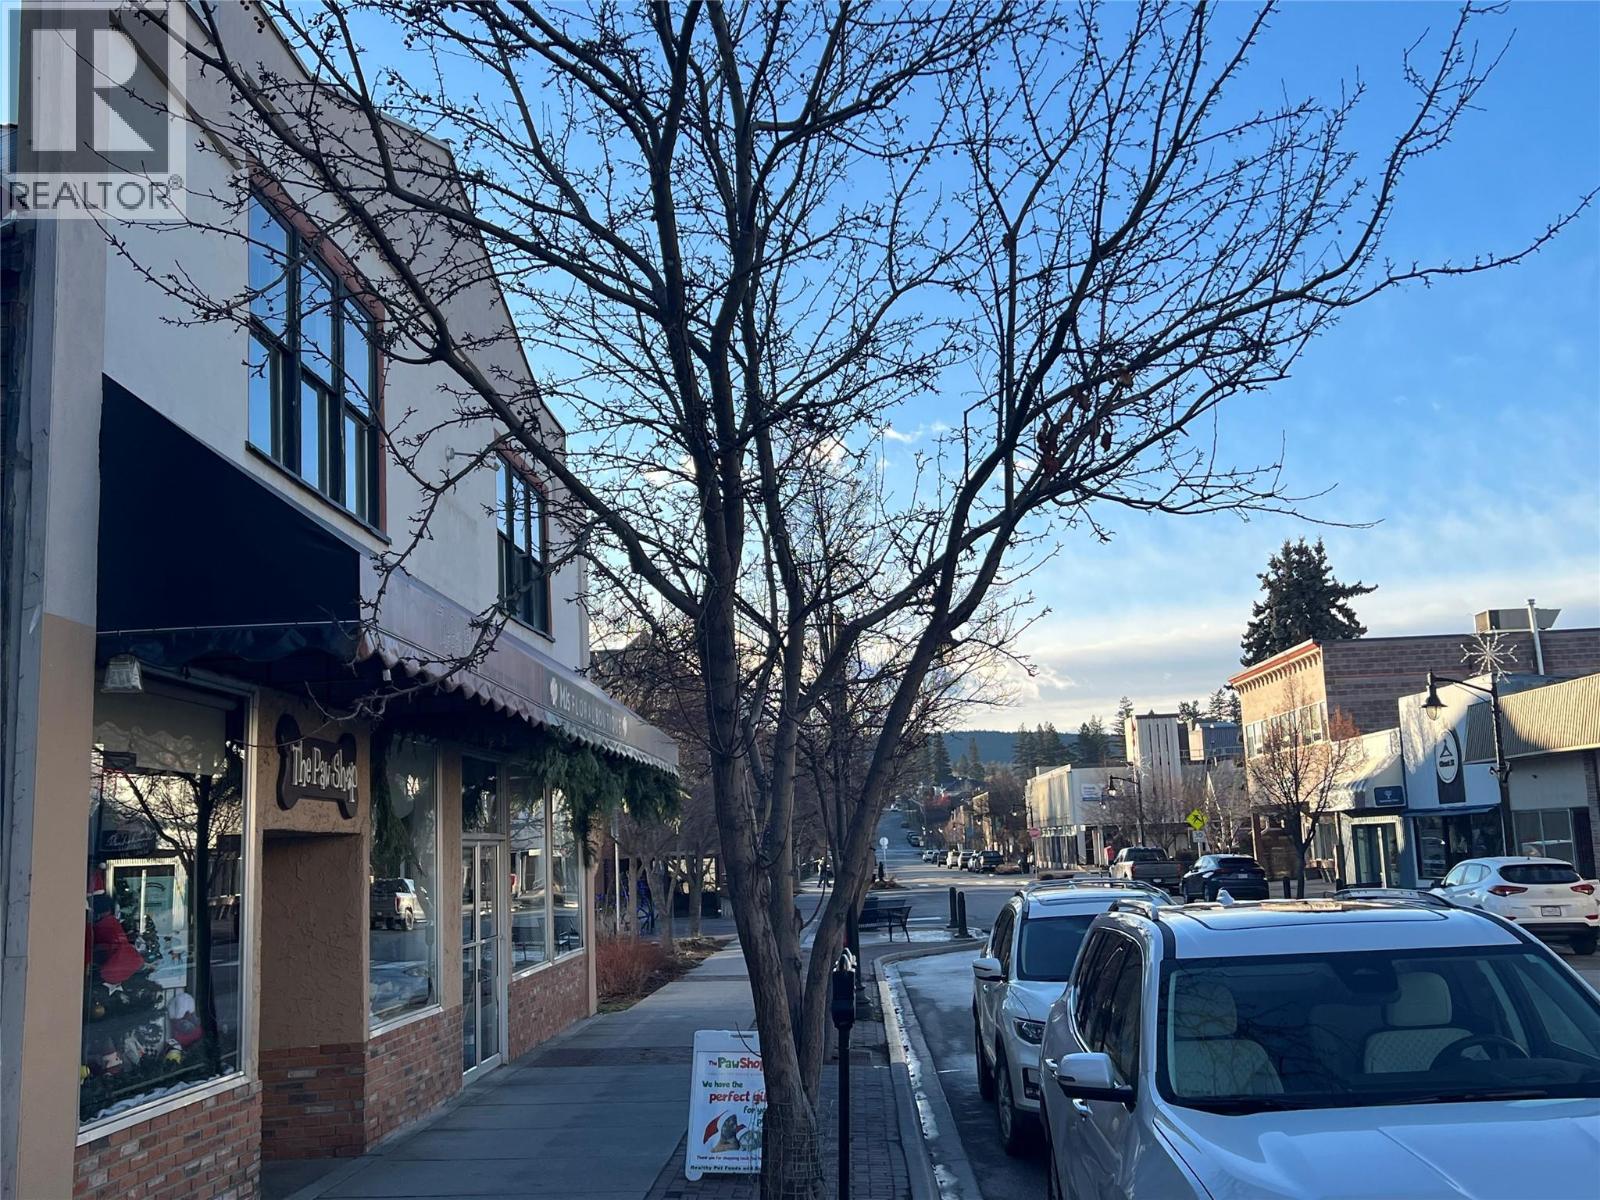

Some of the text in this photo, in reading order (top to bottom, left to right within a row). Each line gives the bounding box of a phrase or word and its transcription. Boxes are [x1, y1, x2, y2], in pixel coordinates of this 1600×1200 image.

[292, 740, 358, 803] The Paw Shop
[702, 1080, 743, 1088] We have the
[709, 1091, 767, 1104] perfect gi
